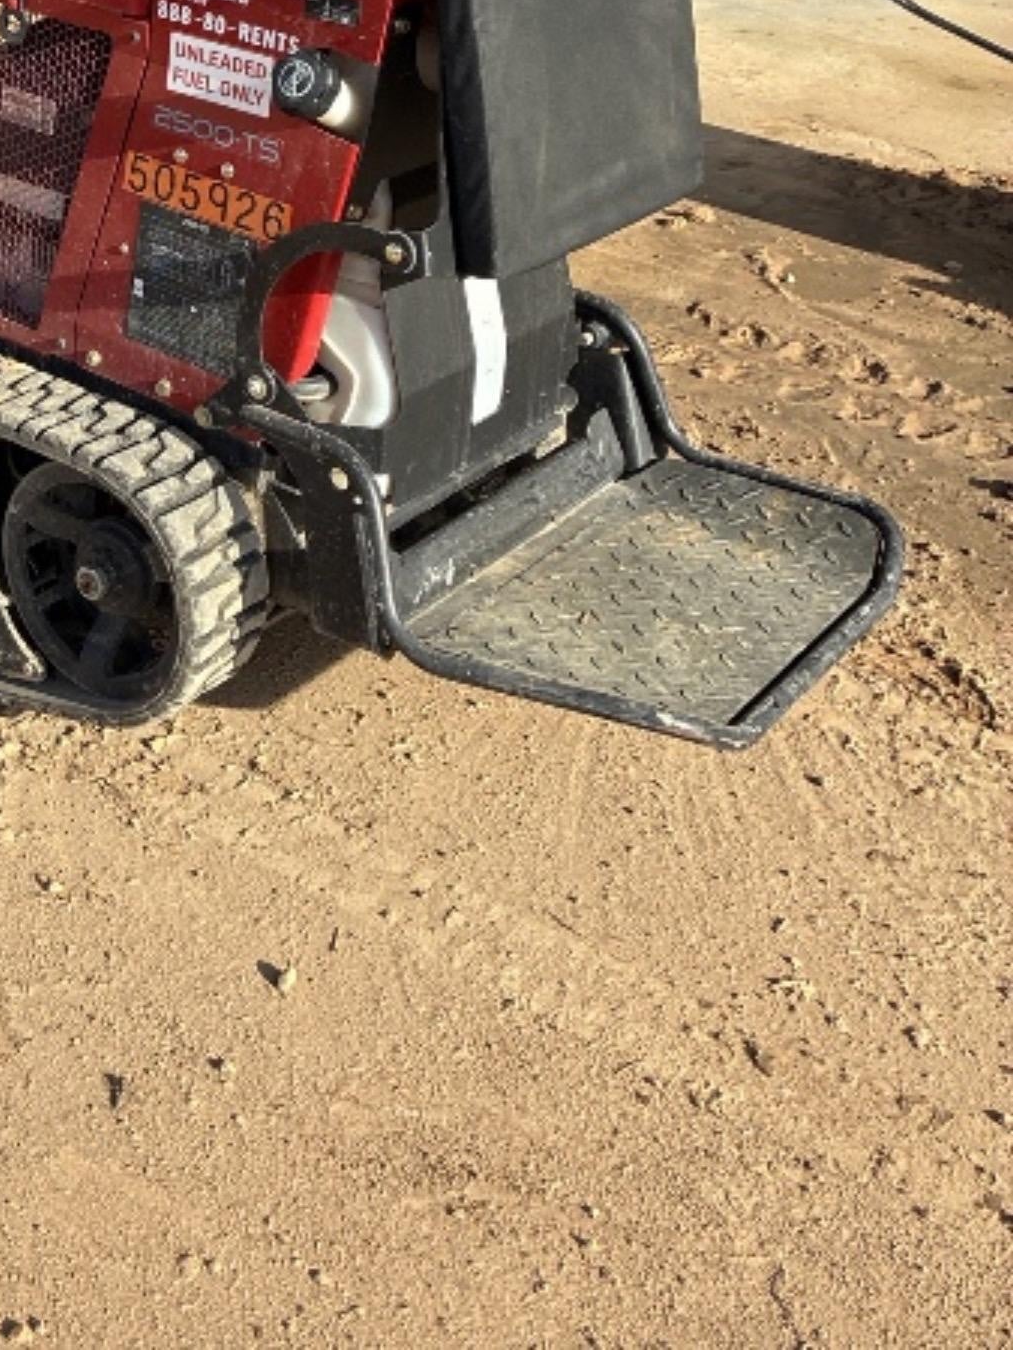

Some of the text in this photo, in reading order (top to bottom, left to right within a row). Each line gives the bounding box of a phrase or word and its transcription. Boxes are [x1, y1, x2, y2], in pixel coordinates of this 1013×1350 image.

[156, 0, 301, 55] 888-80-RENTS
[174, 41, 267, 79] UNLEADED
[172, 65, 264, 106] FUEL ONLY
[127, 153, 286, 240] 505926
